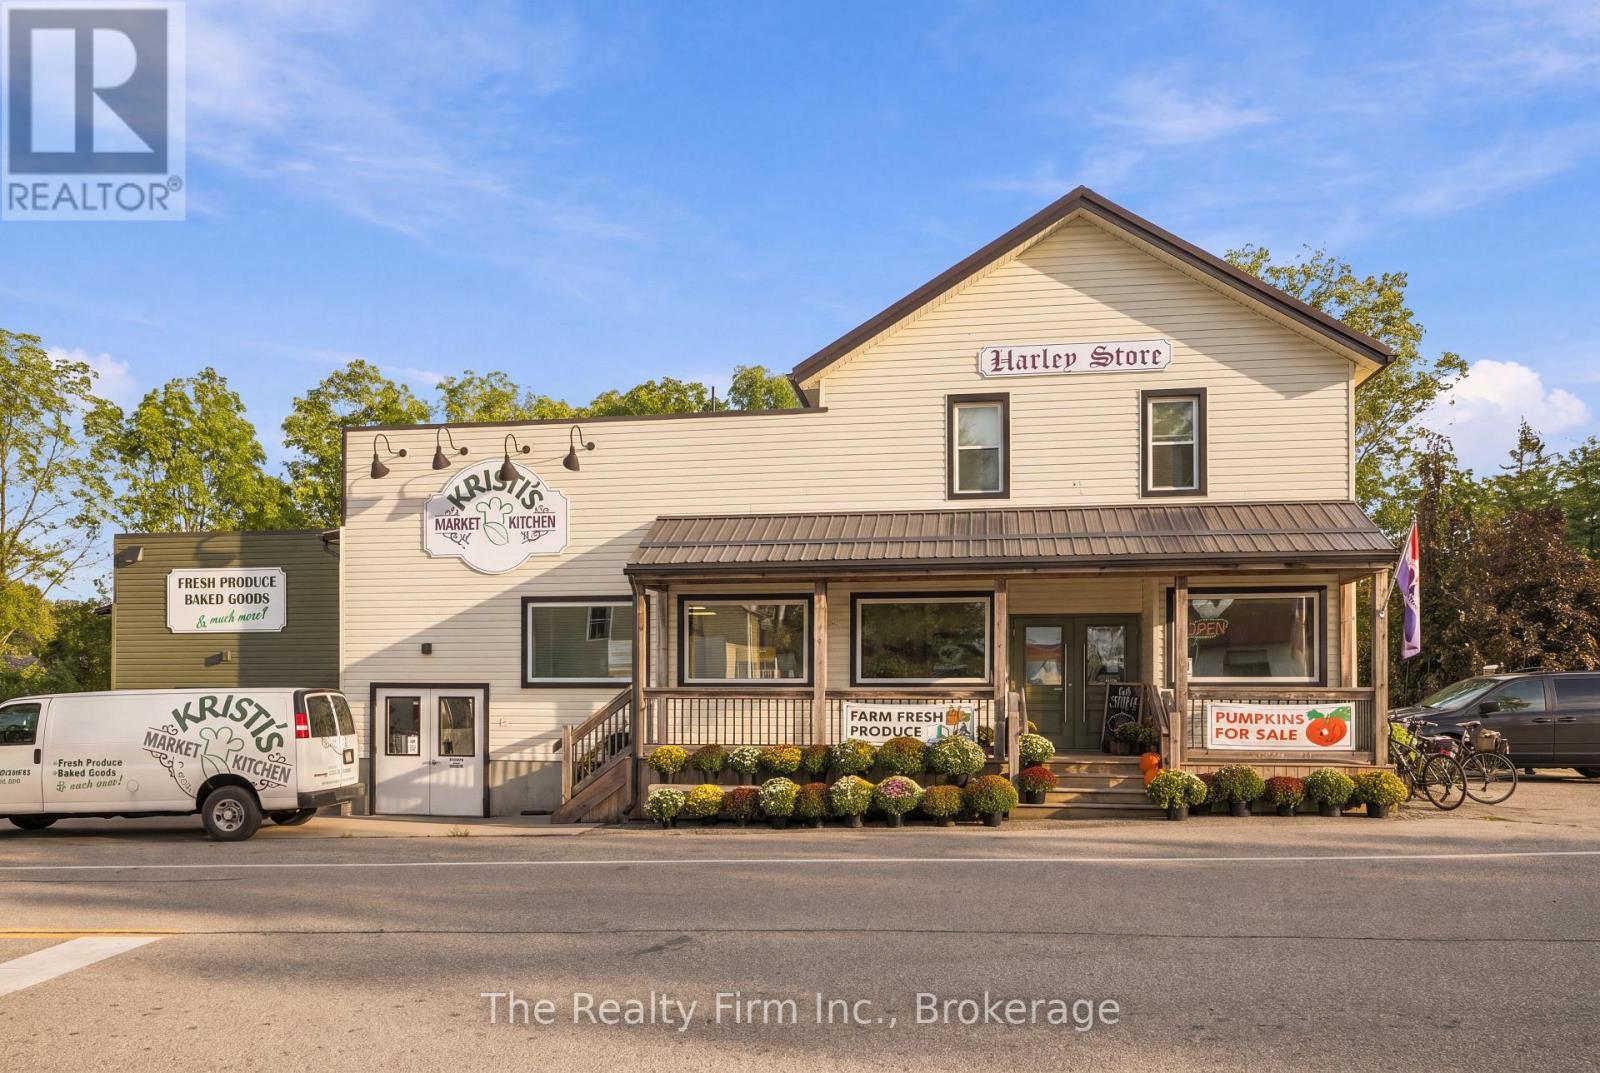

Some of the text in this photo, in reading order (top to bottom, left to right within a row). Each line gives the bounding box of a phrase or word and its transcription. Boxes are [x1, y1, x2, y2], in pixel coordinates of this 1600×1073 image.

[990, 345, 1162, 372] Harley Store
[435, 517, 480, 531] MARKET
[509, 515, 556, 529] KITCHEN
[178, 576, 277, 589] FRESH PRODUCE
[185, 592, 270, 605] BAKED GOODS
[196, 606, 269, 629] & much more!
[171, 694, 289, 753] KRISTI'S
[851, 711, 943, 723] FARM FRESH
[1215, 711, 1305, 725] PUMPKINS
[851, 726, 922, 737] PRODUCE
[1215, 727, 1298, 741] FOR SALE
[143, 730, 203, 758] MARKET
[58, 758, 123, 767] Fresh Produce
[231, 754, 292, 784] KITCHEN
[58, 768, 117, 777] Baked Goods
